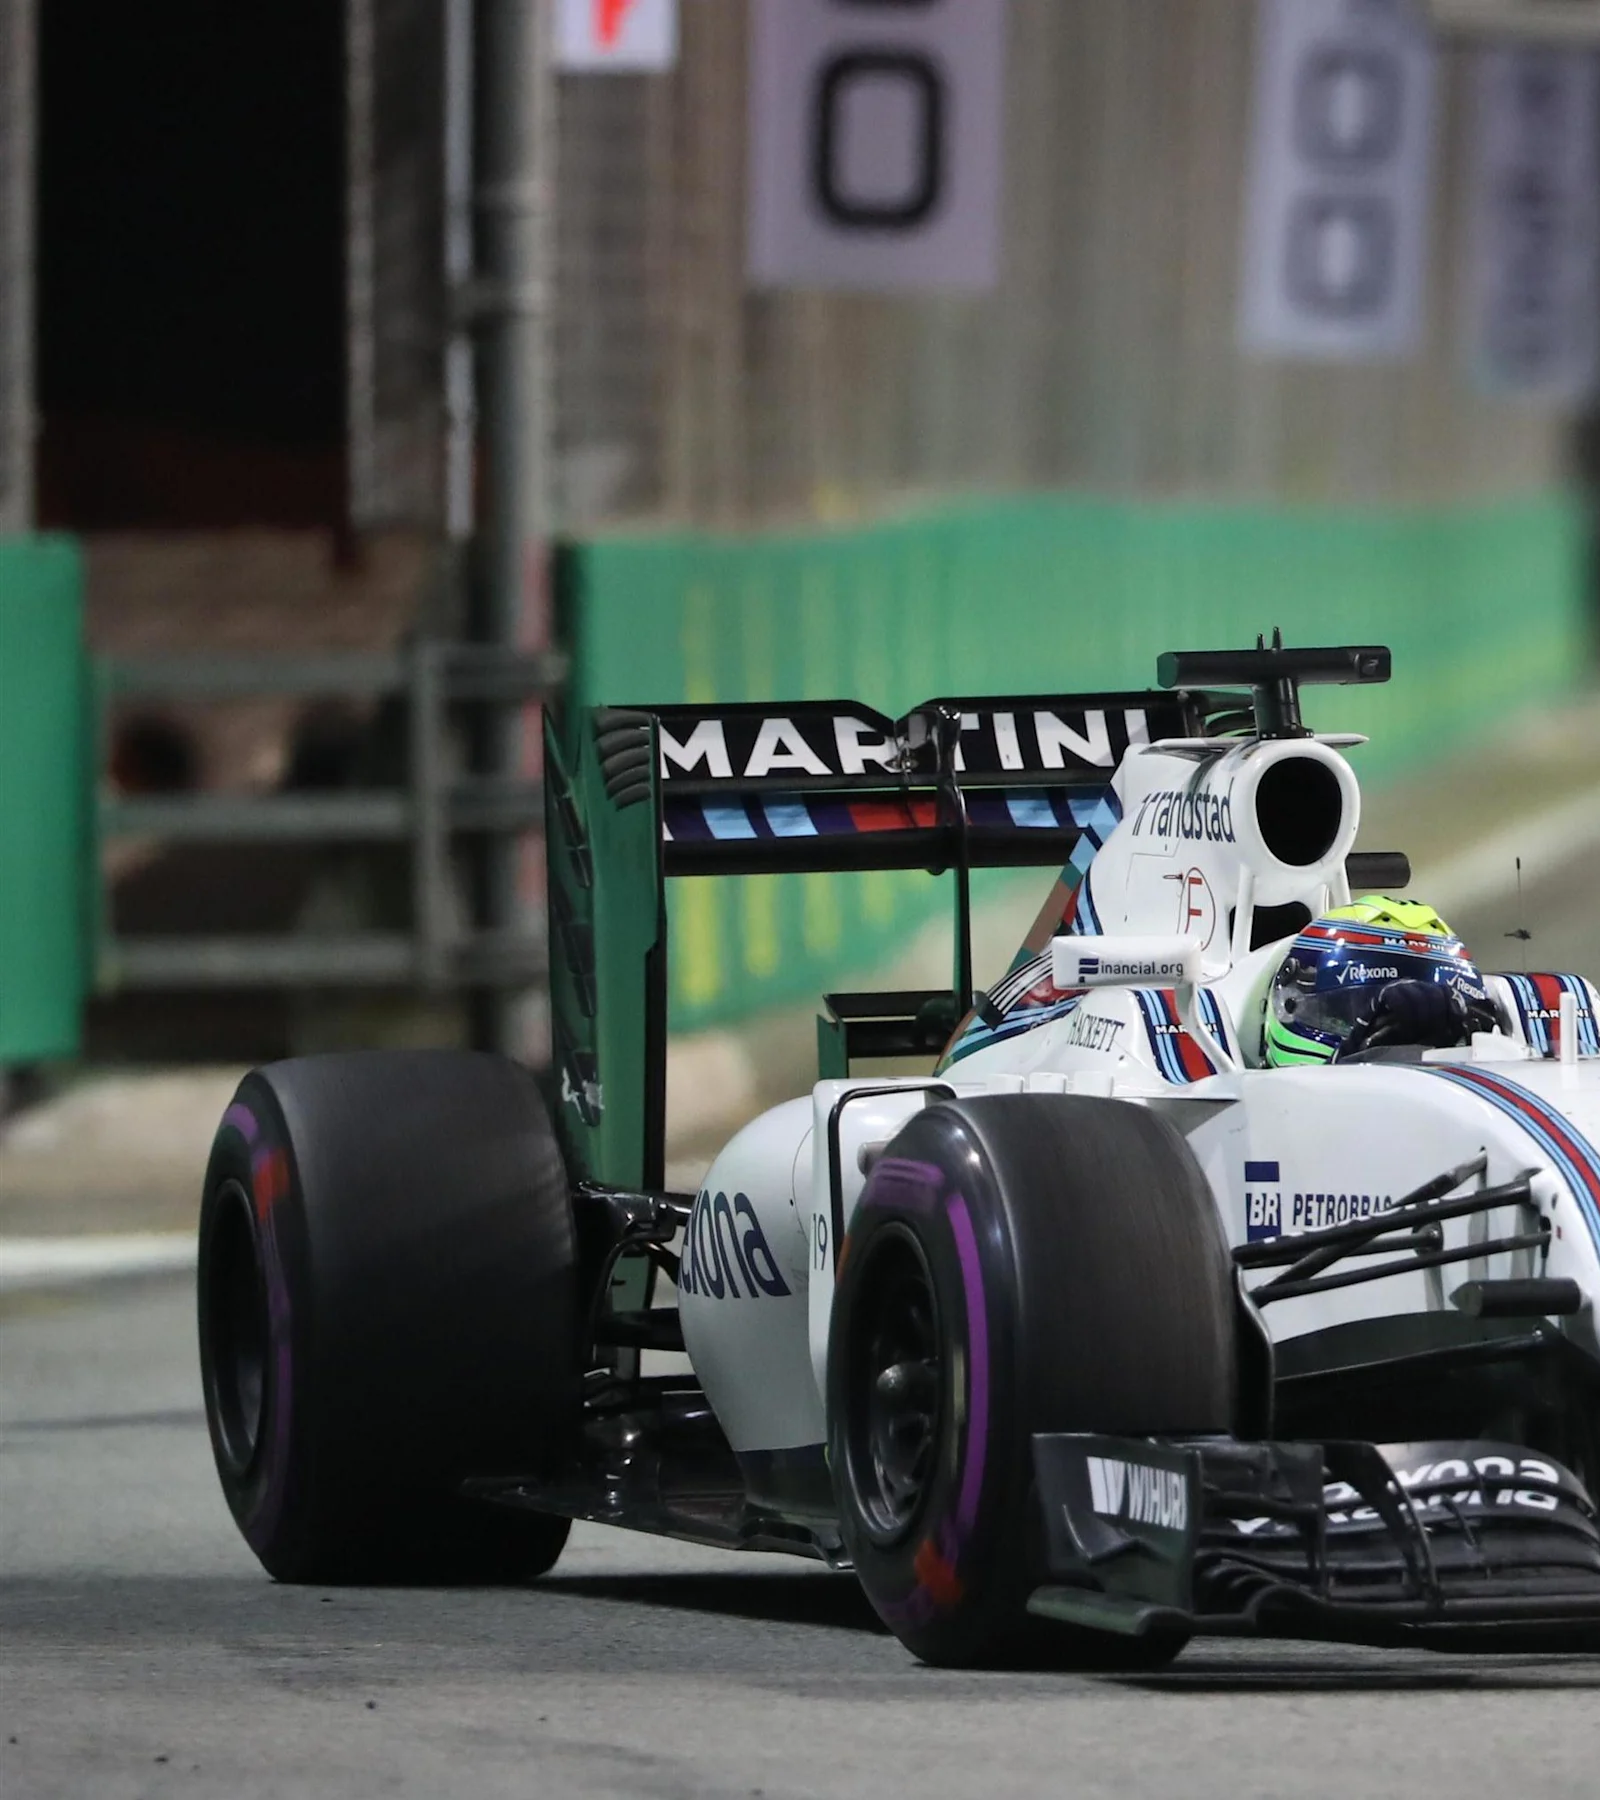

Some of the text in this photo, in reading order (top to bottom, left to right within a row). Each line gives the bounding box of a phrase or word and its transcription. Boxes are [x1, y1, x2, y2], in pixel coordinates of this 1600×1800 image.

[1148, 776, 1236, 843] randstad
[1350, 965, 1398, 981] Rexona
[1527, 1009, 1590, 1019] MARNI
[1248, 1193, 1279, 1227] BR
[812, 1212, 828, 1272] 19
